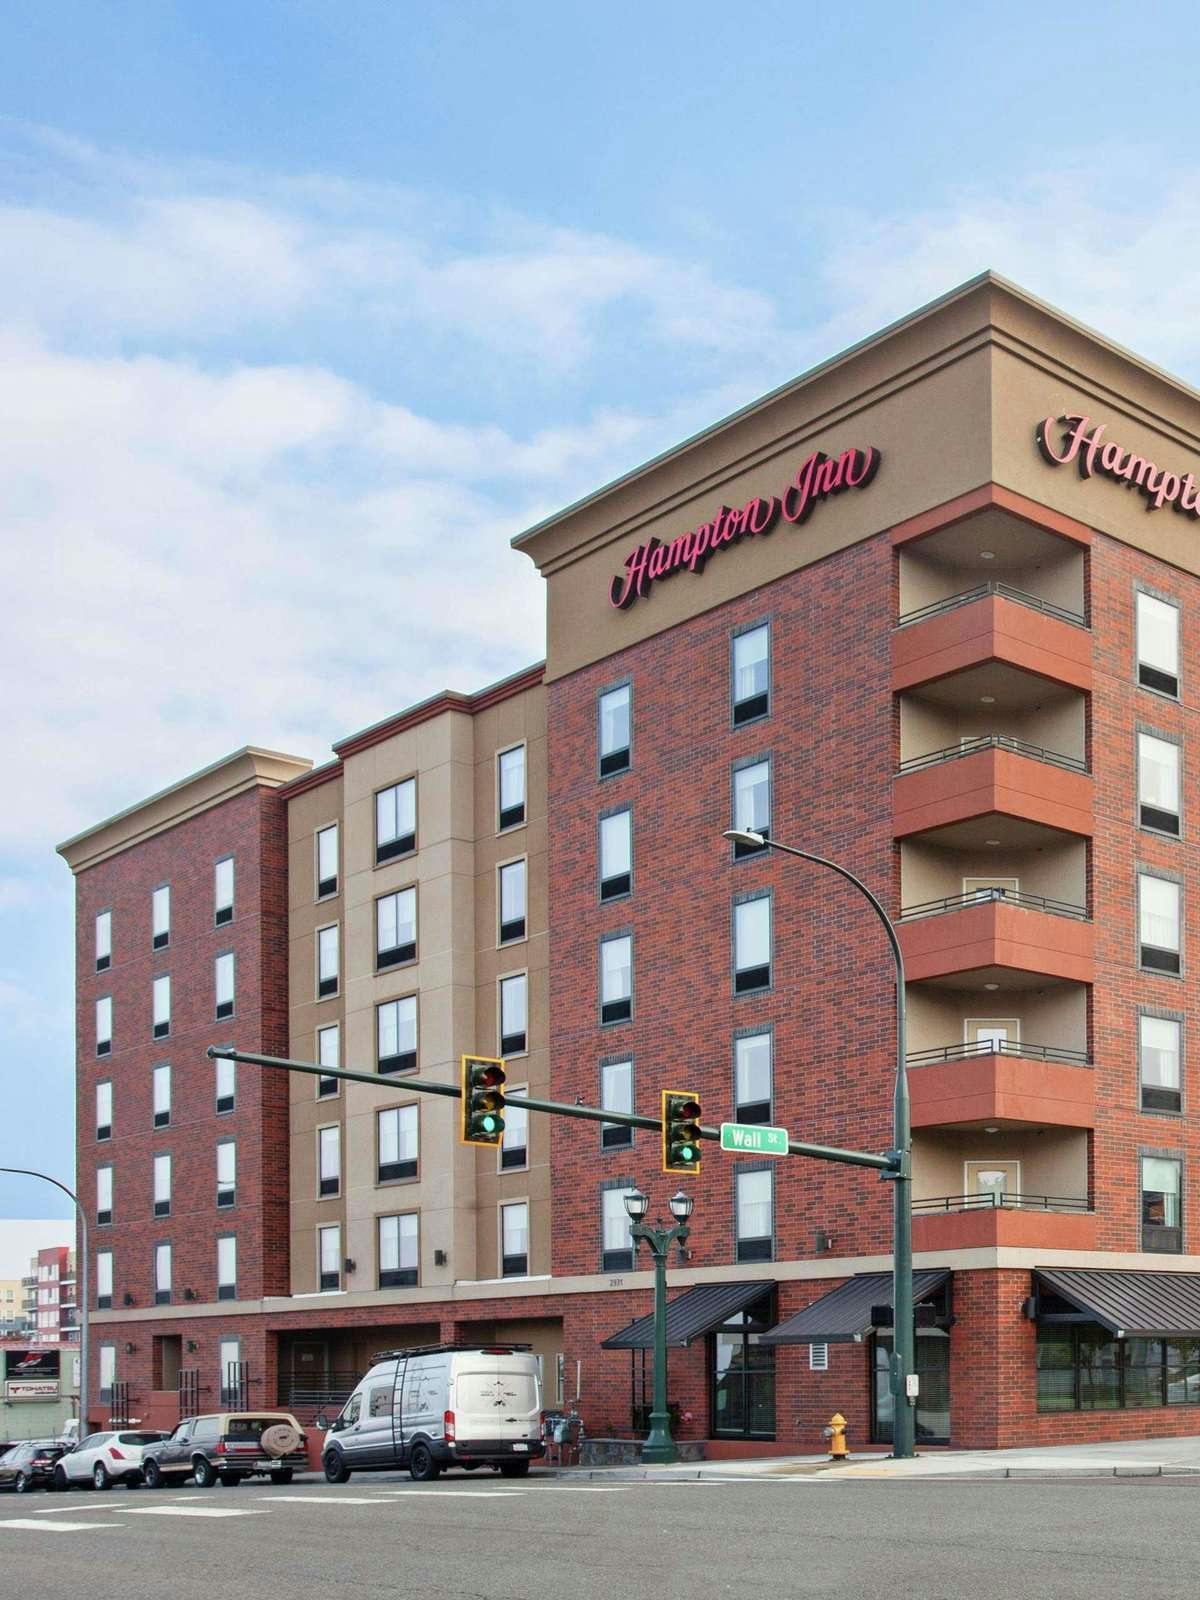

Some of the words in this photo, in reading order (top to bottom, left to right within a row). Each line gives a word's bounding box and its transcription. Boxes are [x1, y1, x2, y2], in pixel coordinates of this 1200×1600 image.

[608, 496, 779, 609] Hampton
[781, 447, 880, 524] Inn
[732, 1129, 761, 1148] Wall
